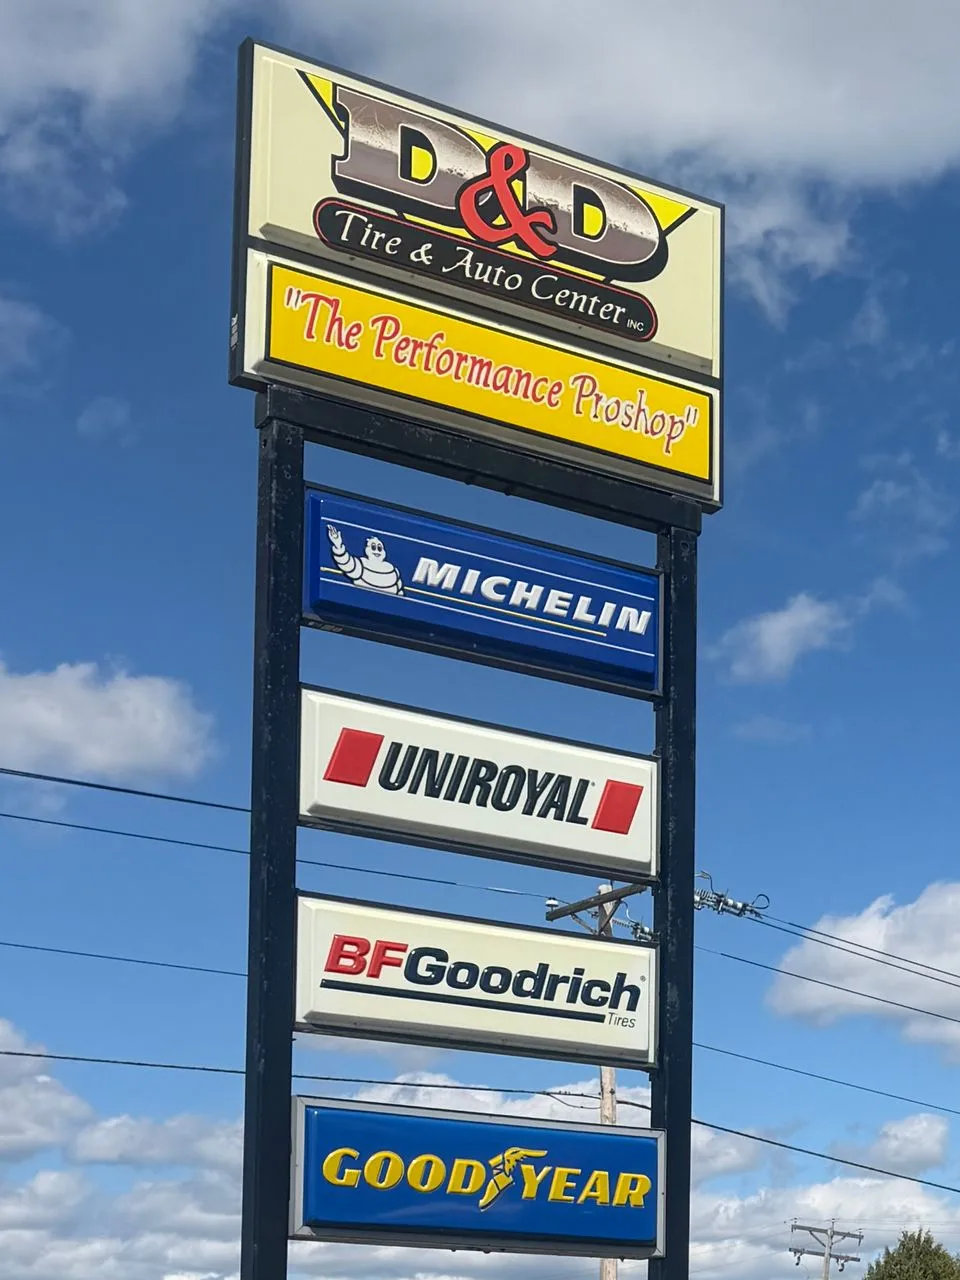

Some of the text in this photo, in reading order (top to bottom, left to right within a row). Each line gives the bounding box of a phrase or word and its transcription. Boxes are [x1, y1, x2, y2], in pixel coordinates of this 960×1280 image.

[332, 84, 665, 272] D&D
[335, 210, 402, 256] Tire
[409, 243, 433, 265] &
[442, 246, 523, 292] Auto
[531, 274, 627, 325] Center
[285, 287, 360, 352] "The
[369, 314, 563, 408] Performance
[570, 373, 699, 455] Proshop"
[412, 556, 652, 635] MICHELIN
[378, 741, 591, 825] UNIROYAL
[324, 934, 641, 1012] BFGoodrich
[607, 1012, 636, 1029] Tires
